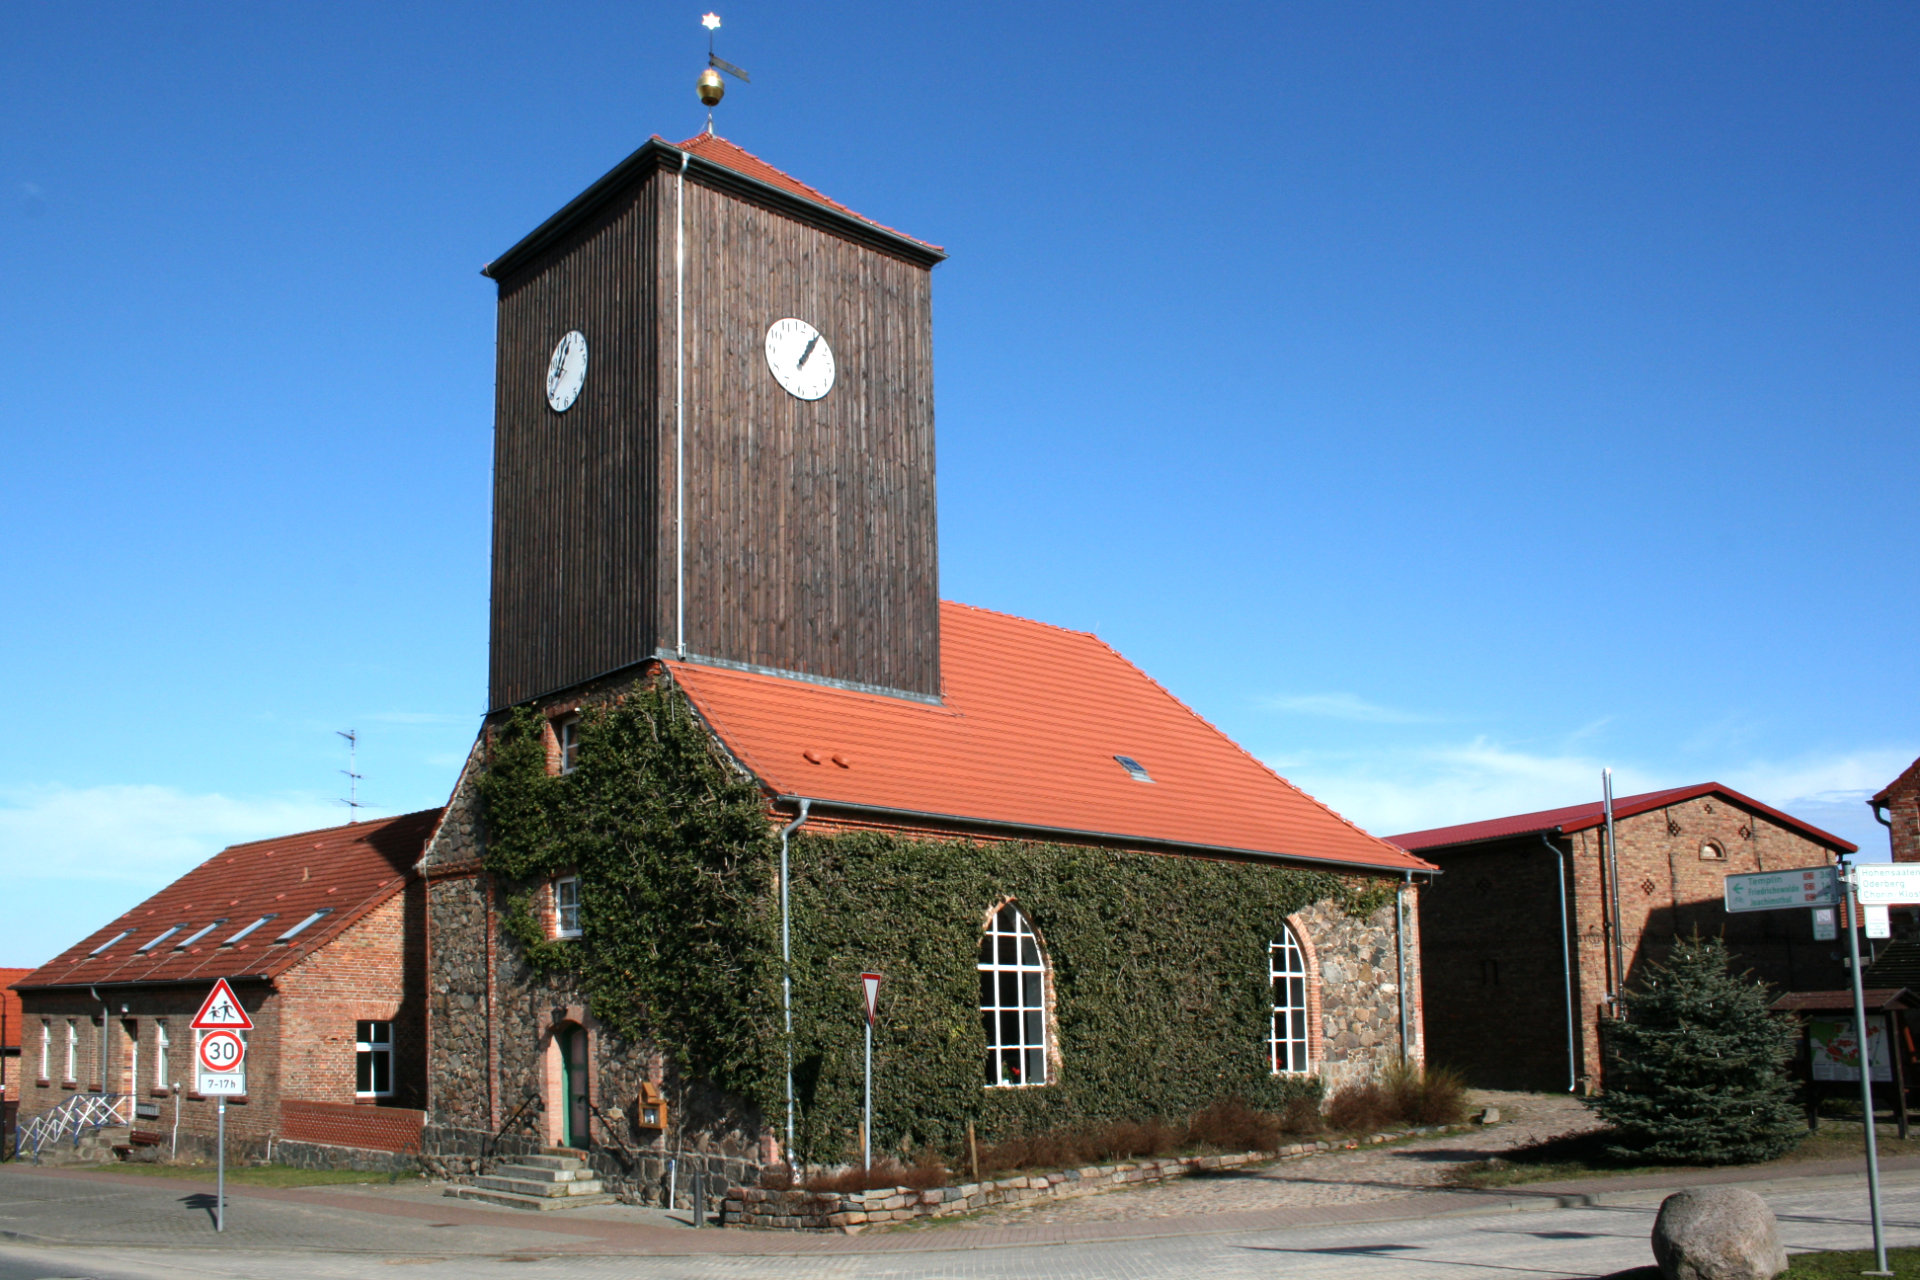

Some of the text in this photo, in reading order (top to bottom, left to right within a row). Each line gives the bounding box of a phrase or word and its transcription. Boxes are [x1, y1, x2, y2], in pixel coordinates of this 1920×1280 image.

[1748, 876, 1783, 886] Templin
[1863, 879, 1905, 889] Oderberg
[209, 1042, 235, 1060] 30
